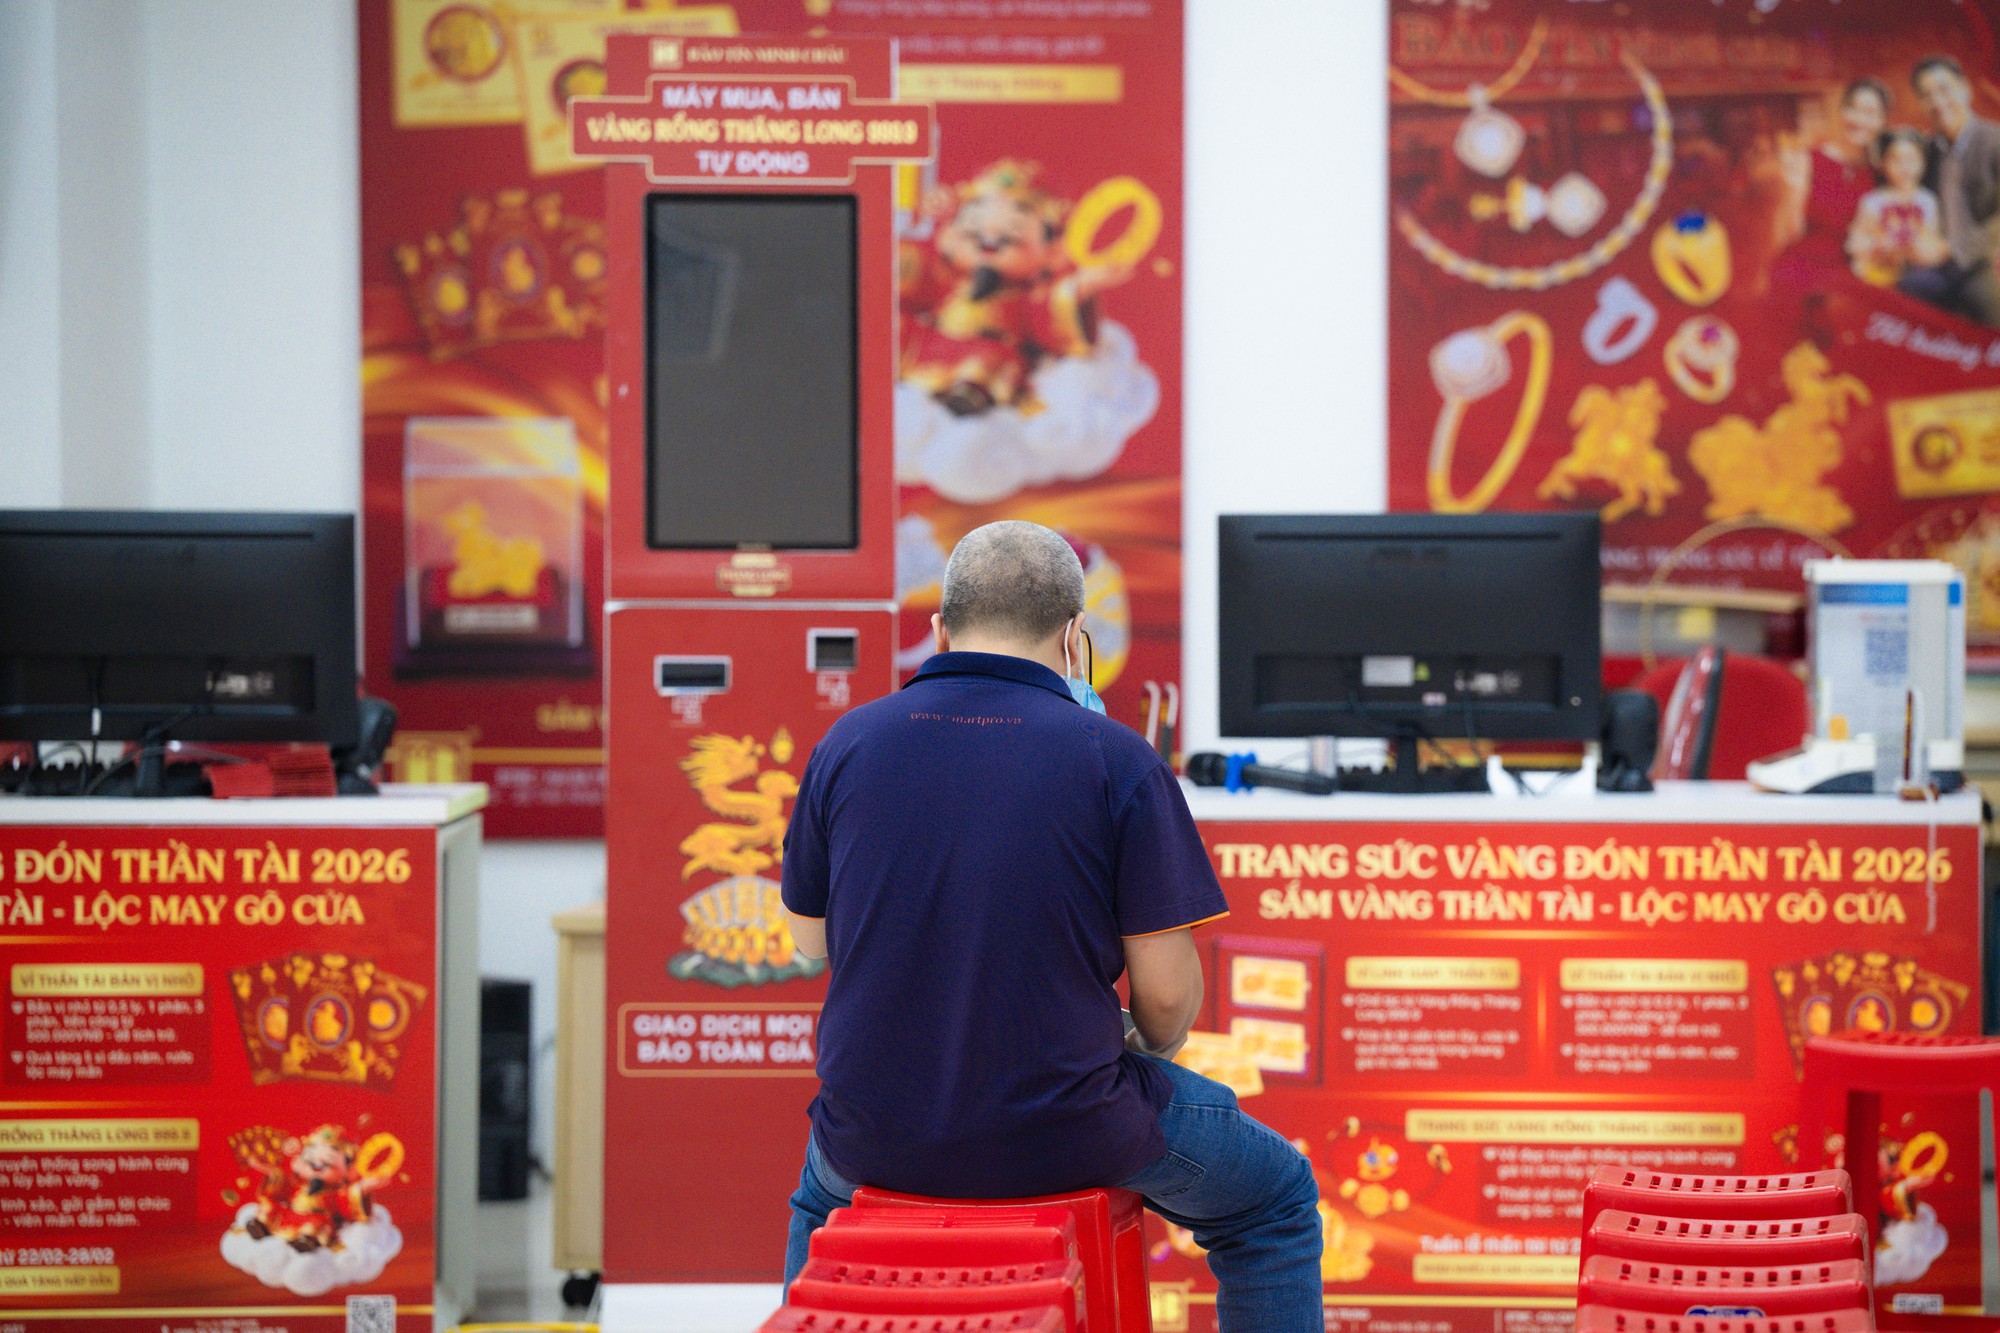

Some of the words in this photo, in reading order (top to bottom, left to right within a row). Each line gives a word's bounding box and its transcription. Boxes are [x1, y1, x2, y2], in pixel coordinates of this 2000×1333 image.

[662, 82, 718, 109] MÁY
[721, 86, 784, 112] MUA,
[787, 83, 842, 110] BÁN
[586, 111, 651, 143] VÀNG
[654, 111, 720, 143] RỒNG
[724, 114, 800, 144] THĂNG
[803, 119, 865, 145] LONG
[696, 150, 733, 177] TỰ
[735, 150, 809, 177] ĐỘNG
[14, 840, 102, 884] ĐÓN
[112, 838, 226, 884] THẦN
[234, 840, 300, 884] TÀI
[311, 848, 412, 884] 2026
[1213, 842, 1349, 879] TRANG
[1355, 838, 1438, 880] SỨC
[1444, 837, 1557, 880] VÀNG
[1564, 837, 1649, 880] ĐÓN
[1658, 836, 1769, 881] THẦN
[1776, 838, 1842, 882] TÀI
[1852, 847, 1953, 883] 2026
[74, 889, 143, 931] LỘC
[149, 894, 228, 925] MAY
[292, 888, 365, 925] CỬA
[1258, 879, 1333, 920] SẮM
[1338, 882, 1434, 920] VÀNG
[1437, 882, 1532, 921] THẦN
[1537, 884, 1595, 922] TÀI
[1619, 886, 1688, 928] LỘC
[1693, 892, 1770, 923] MAY
[1833, 886, 1907, 924] CỬA
[633, 1014, 697, 1037] GIAO
[701, 1014, 761, 1040] DỊCH
[766, 1014, 813, 1040] MỌI
[637, 1035, 692, 1063] BẢO
[695, 1036, 764, 1063] TOÀN
[768, 1036, 815, 1063] GIÁ
[50, 1127, 101, 1144] THĂNG
[106, 1127, 149, 1144] LONG
